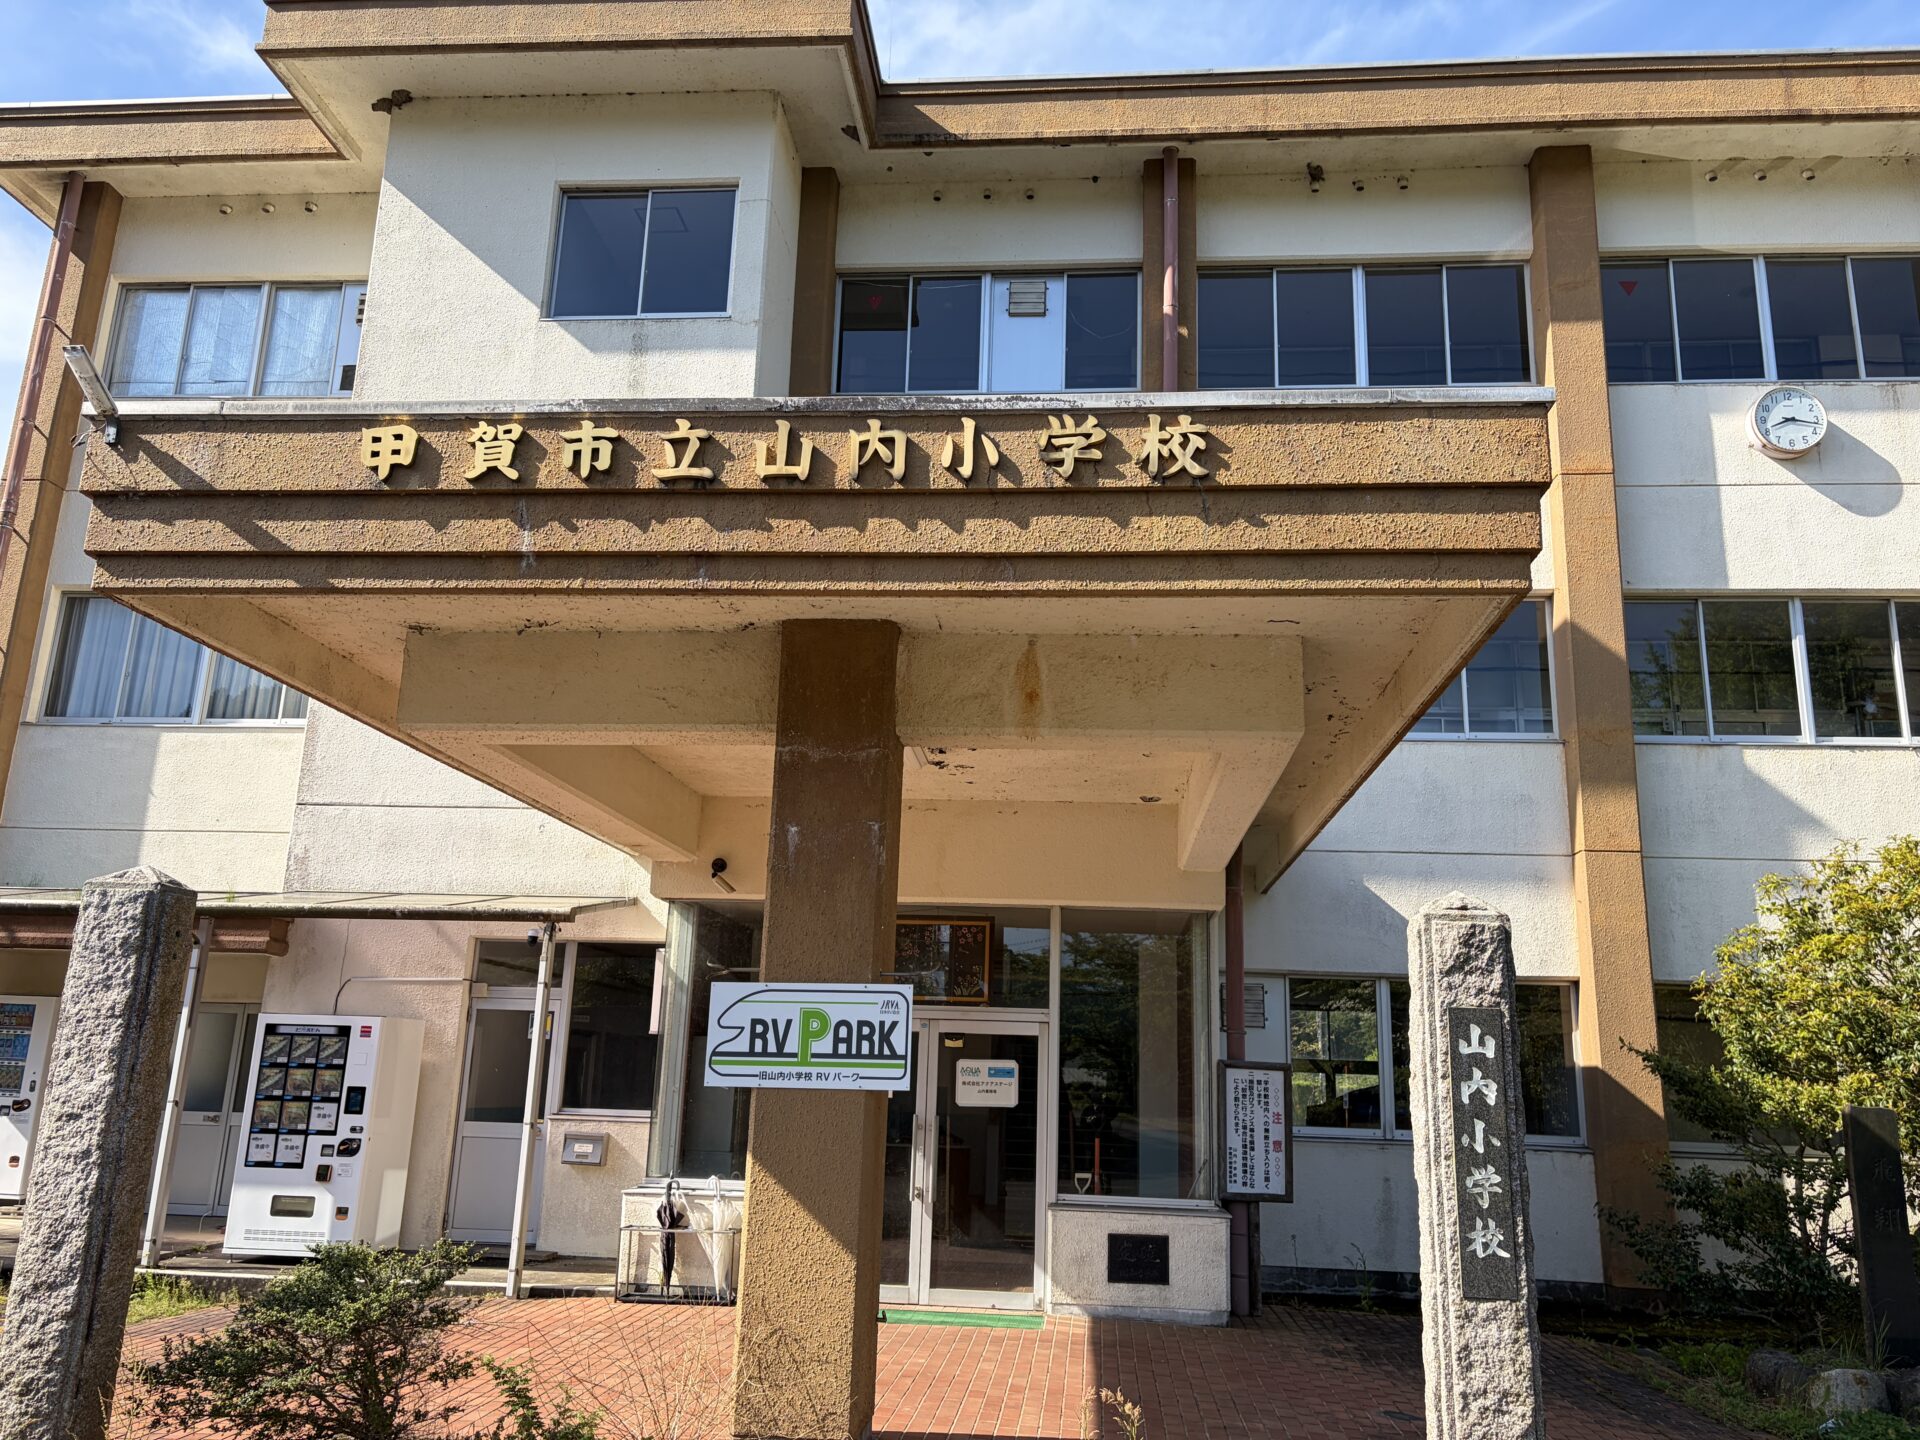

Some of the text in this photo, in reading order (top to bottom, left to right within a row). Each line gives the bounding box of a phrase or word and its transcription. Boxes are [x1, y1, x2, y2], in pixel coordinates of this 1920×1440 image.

[1770, 396, 1778, 404] 11
[1783, 392, 1792, 401] 12
[1799, 396, 1803, 404] 1
[1761, 404, 1770, 413] 10
[1808, 404, 1814, 412] 2
[1760, 416, 1767, 424] 9
[1813, 415, 1820, 425] 3
[1764, 428, 1771, 436] 8
[1811, 427, 1818, 436] 4
[1775, 436, 1781, 444] 7
[1789, 439, 1796, 447] 6
[1802, 436, 1809, 444] 5
[360, 413, 1211, 480] 甲賀市立山内小学校
[749, 1007, 900, 1062] RV PARK
[758, 1070, 813, 1082] 旧山内小学校
[816, 1072, 831, 1081] RV
[1458, 1023, 1511, 1259] 山内小学校
